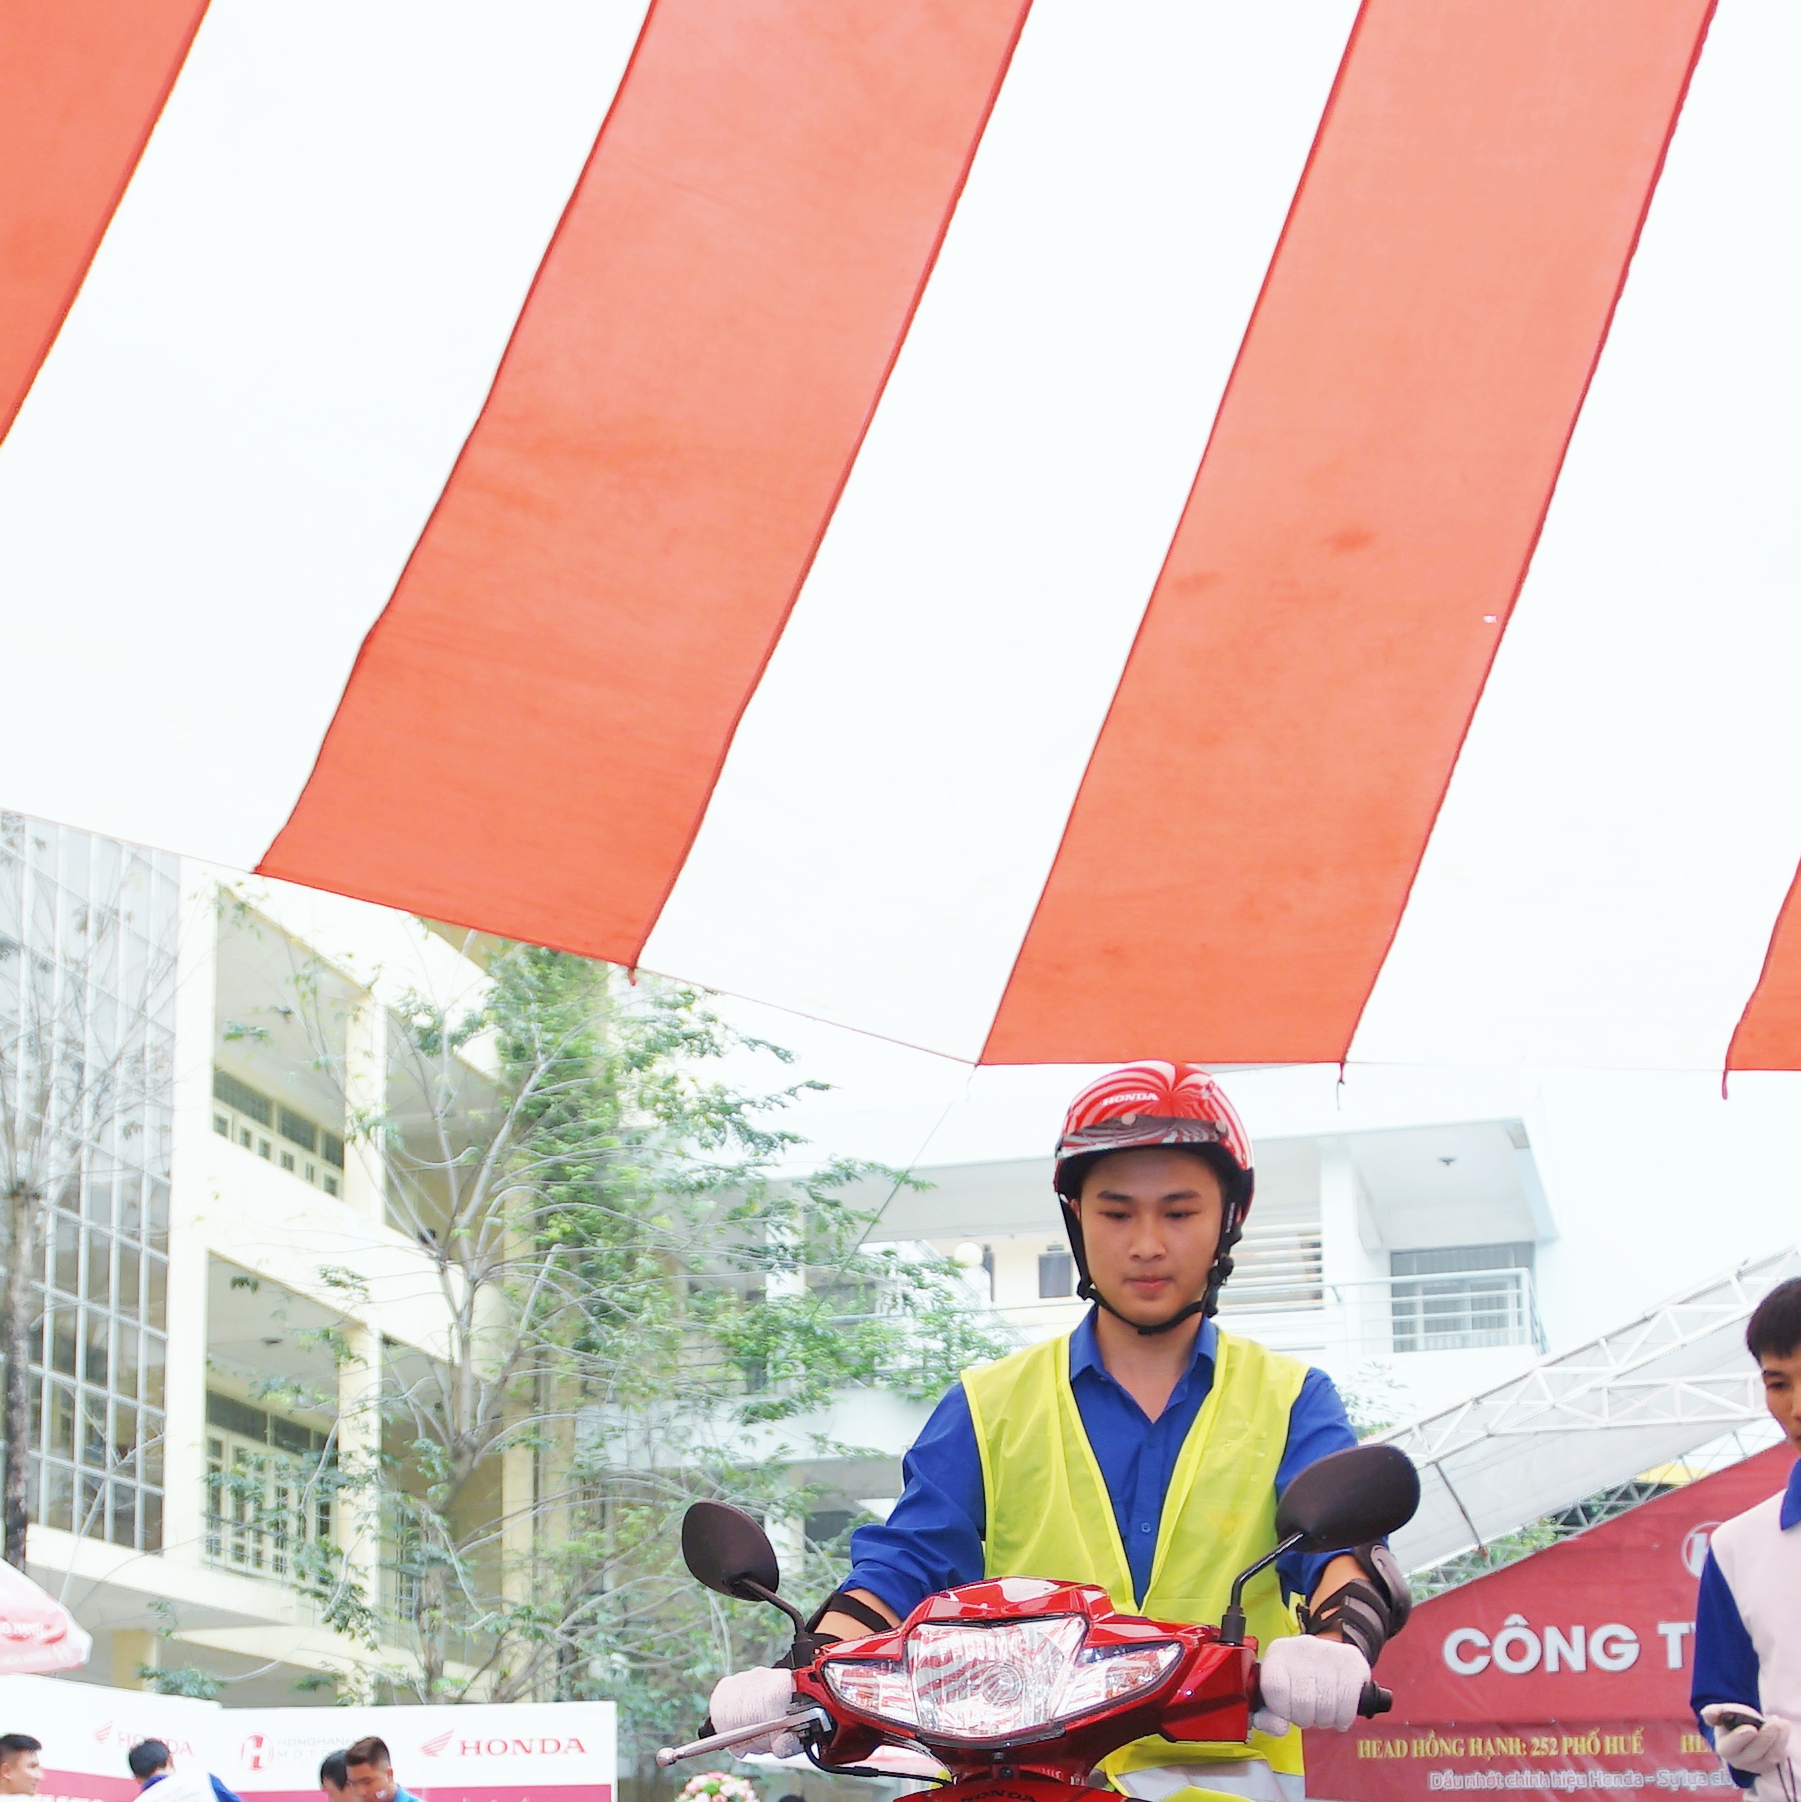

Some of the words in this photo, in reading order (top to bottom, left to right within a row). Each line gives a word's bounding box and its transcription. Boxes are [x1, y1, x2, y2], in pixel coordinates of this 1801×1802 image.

[1102, 1092, 1160, 1106] HONDA
[1442, 1613, 1640, 1676] CÔNG
[1657, 1620, 1697, 1670] T
[117, 1730, 195, 1758] HODA
[459, 1737, 589, 1756] HONDA
[1358, 1738, 1408, 1759] HEAD
[1530, 1736, 1559, 1757] 252
[1588, 1769, 1645, 1789] Honda
